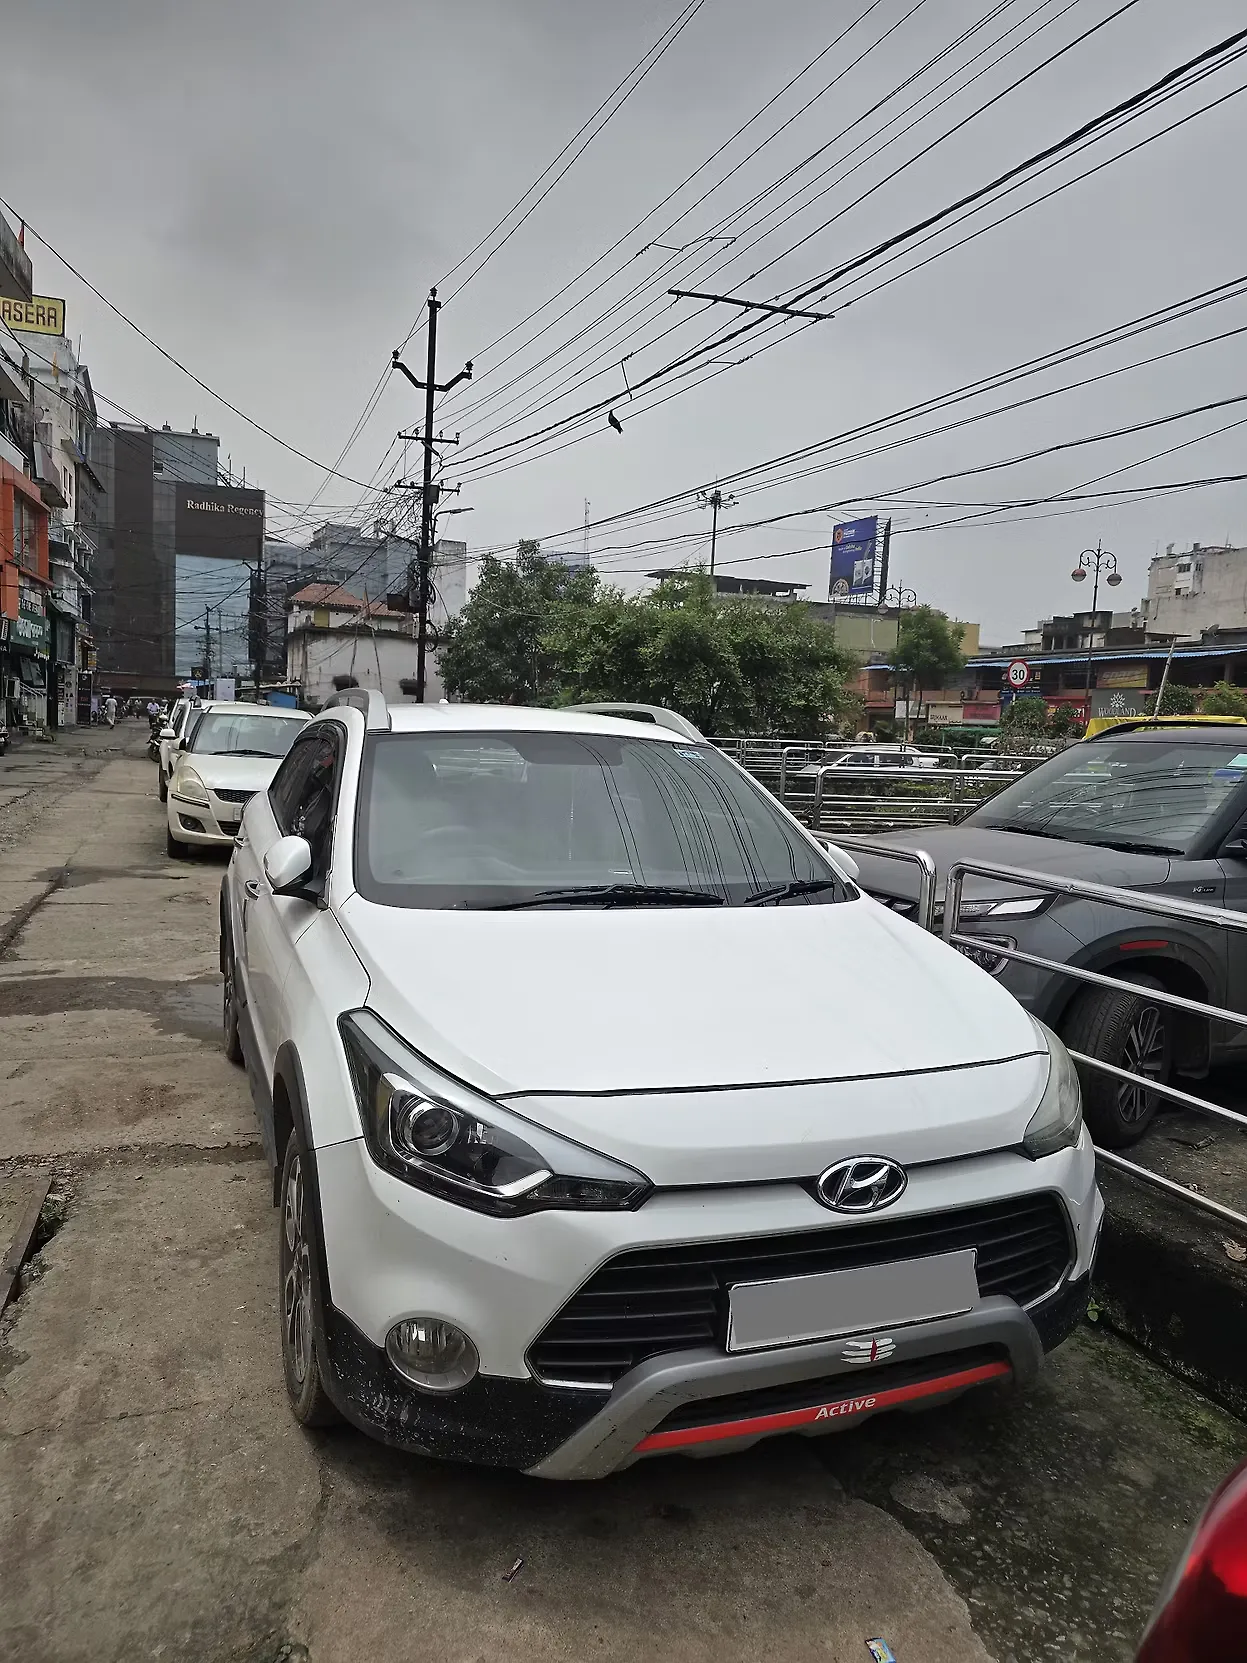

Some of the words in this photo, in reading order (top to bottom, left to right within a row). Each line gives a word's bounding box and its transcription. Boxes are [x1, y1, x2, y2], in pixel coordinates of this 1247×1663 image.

[2, 300, 57, 328] ASERA
[186, 499, 225, 513] Radhika
[227, 504, 264, 518] Regency
[1012, 669, 1025, 681] 30
[1098, 707, 1137, 717] WOODLAND
[814, 1397, 876, 1420] Active
